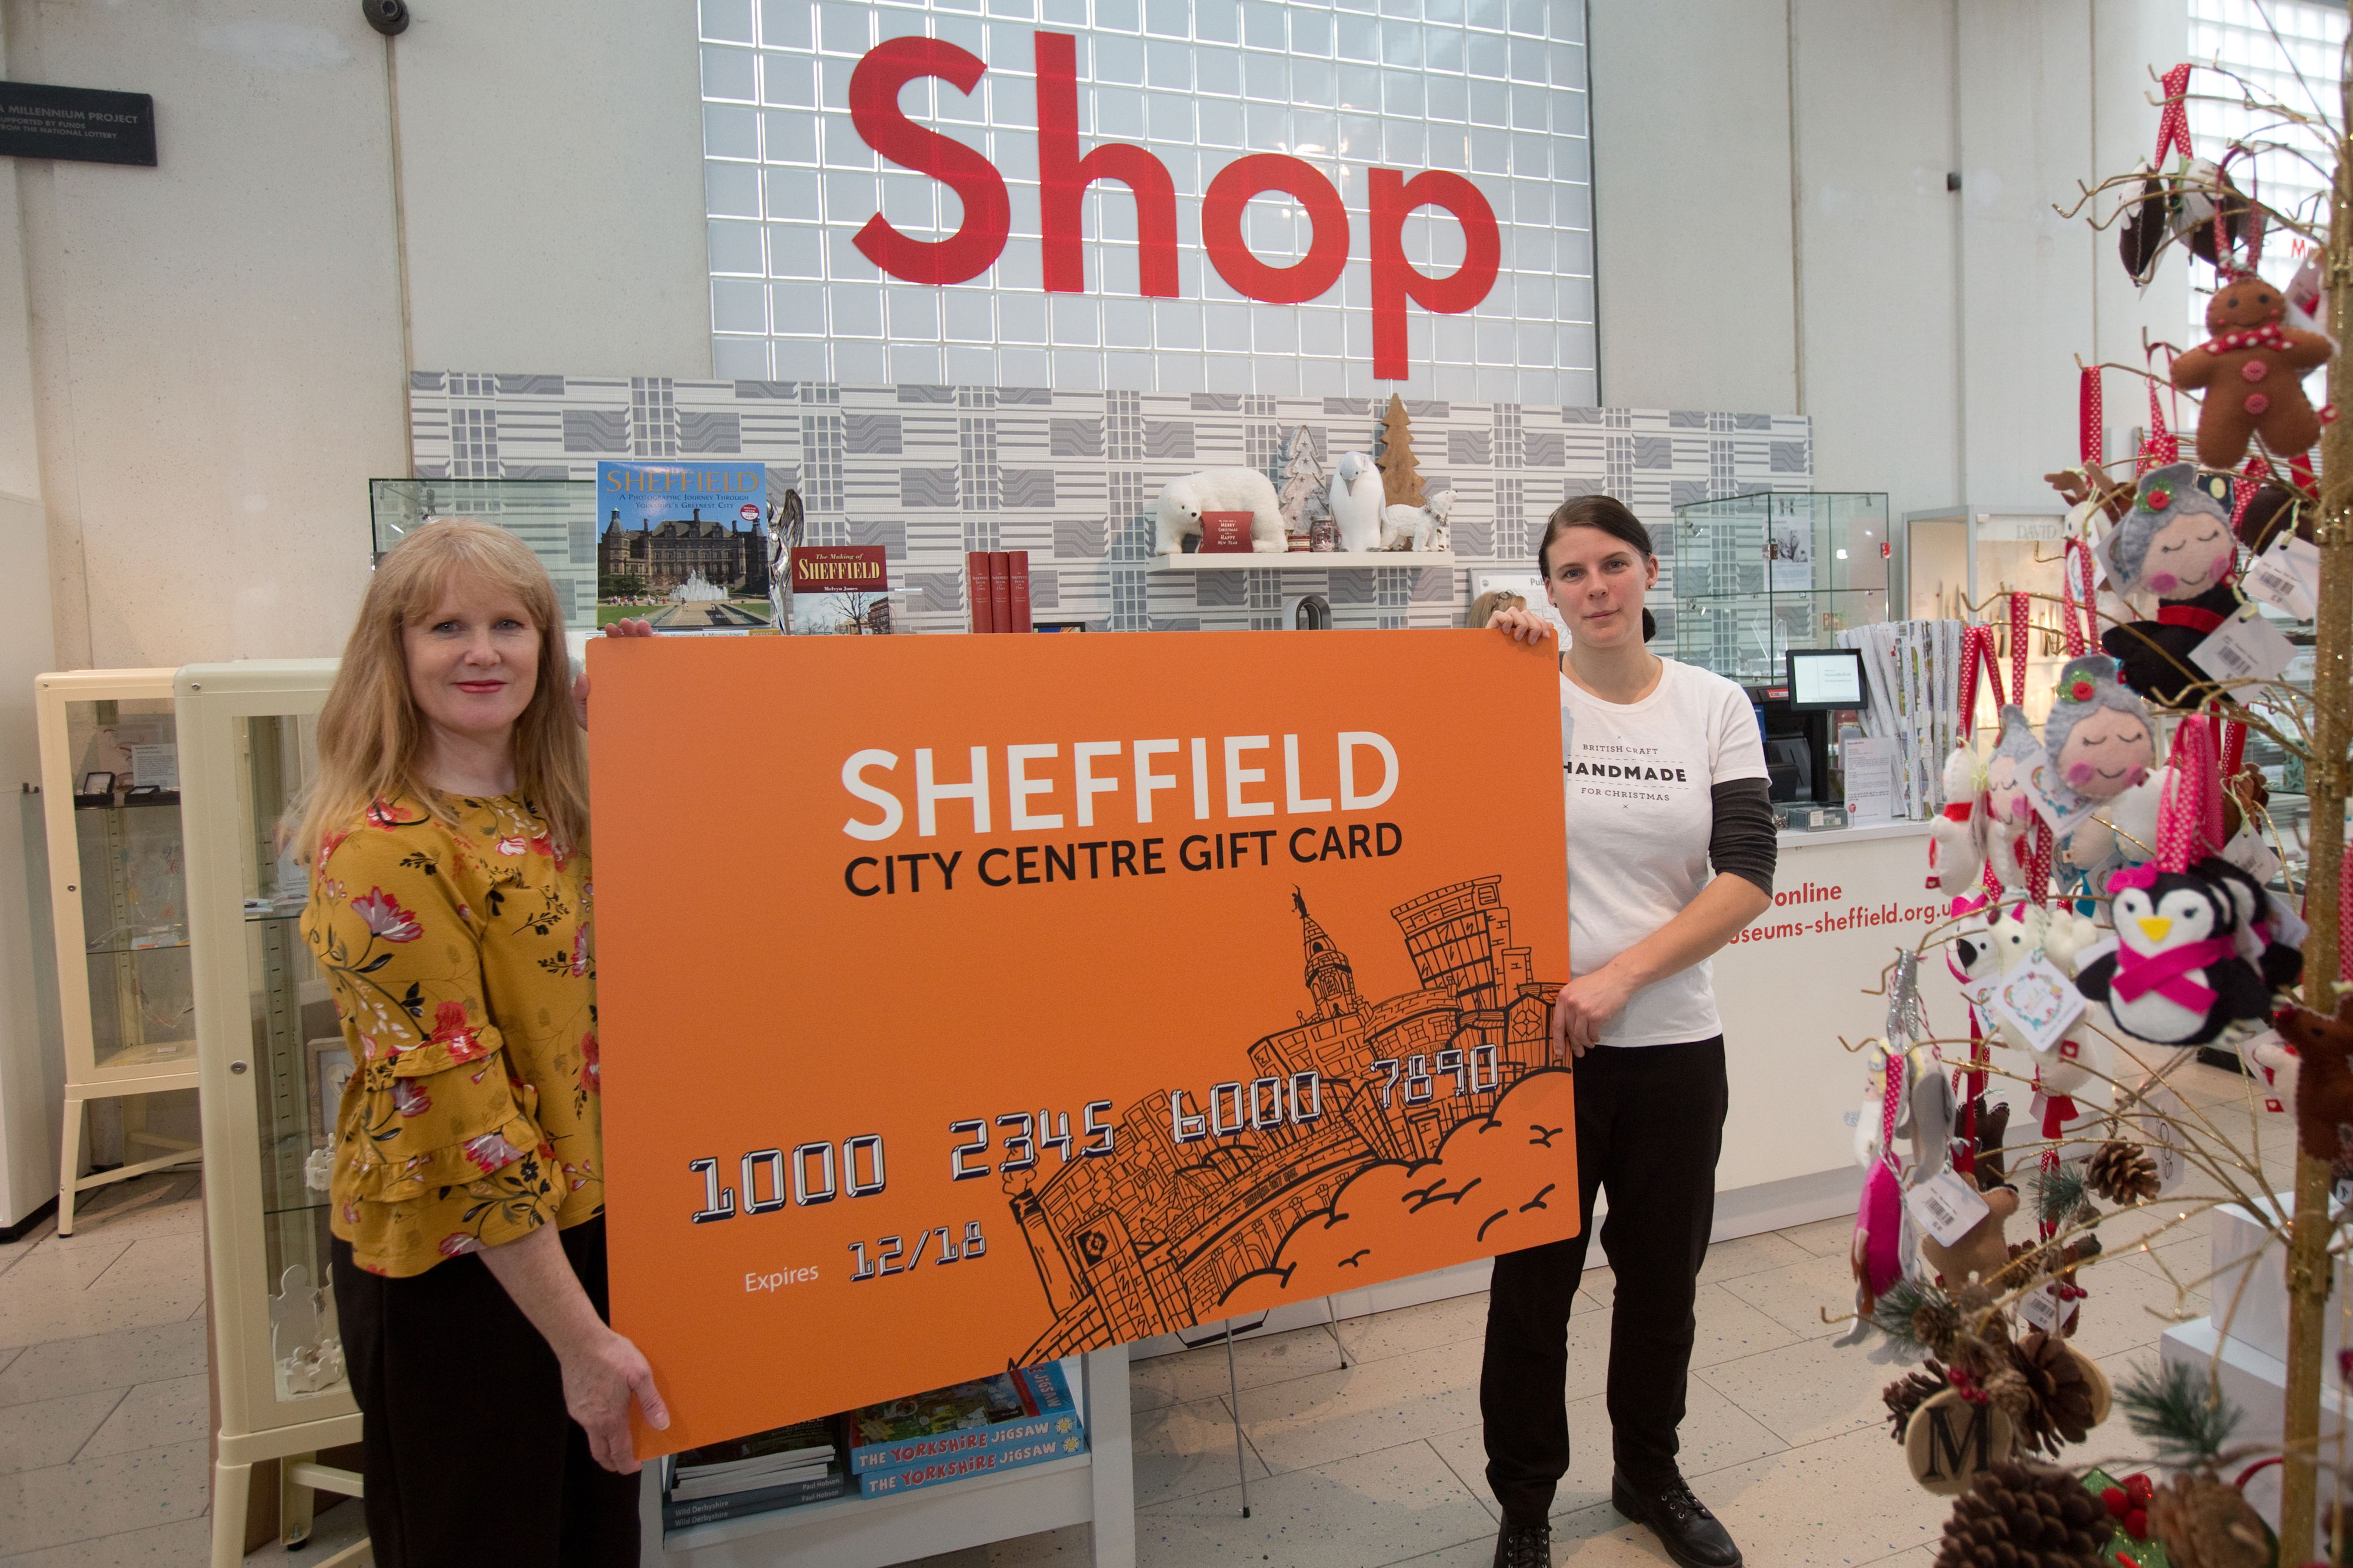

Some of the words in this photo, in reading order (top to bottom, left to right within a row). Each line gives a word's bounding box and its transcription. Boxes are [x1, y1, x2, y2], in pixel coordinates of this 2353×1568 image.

[0, 117, 43, 126] UPPORTED
[9, 105, 85, 119] MILLENNIUM
[89, 112, 138, 124] PROJECT
[40, 127, 82, 136] NATIONAL
[849, 31, 1501, 380] Shop
[605, 471, 759, 492] SHEFFIELD
[2017, 525, 2057, 539] DAVID
[799, 558, 880, 580] SHEFFIELD
[1582, 744, 1623, 752] BRITISH
[1626, 746, 1658, 755] CRAFT
[1563, 761, 1687, 782] HANDMADE
[841, 730, 1400, 842] SHEFFIELD
[1605, 790, 1670, 801] CHRISTMAS
[845, 850, 964, 898] CITY
[978, 838, 1166, 888] CENTRE
[1179, 829, 1278, 872] GIFT
[1288, 822, 1404, 863] CARD
[1774, 882, 1842, 907] online
[689, 1133, 886, 1225] 1000
[949, 1099, 1115, 1182] 2345
[1171, 1069, 1322, 1145] 6000
[1369, 1043, 1499, 1110] 7890
[745, 1263, 819, 1293] Expires
[848, 1220, 986, 1282] 12/18
[1920, 1402, 1993, 1483] M
[859, 1452, 886, 1467] THE
[869, 1475, 898, 1492] THE
[675, 1507, 691, 1517] Wild
[692, 1500, 729, 1514] Derbyshire
[802, 1481, 816, 1490] Paul
[816, 1477, 841, 1487] Hobson
[675, 1518, 691, 1527] Wild
[691, 1510, 729, 1525] Derbyshire
[801, 1492, 815, 1502] Paul
[816, 1489, 839, 1499] Hobson
